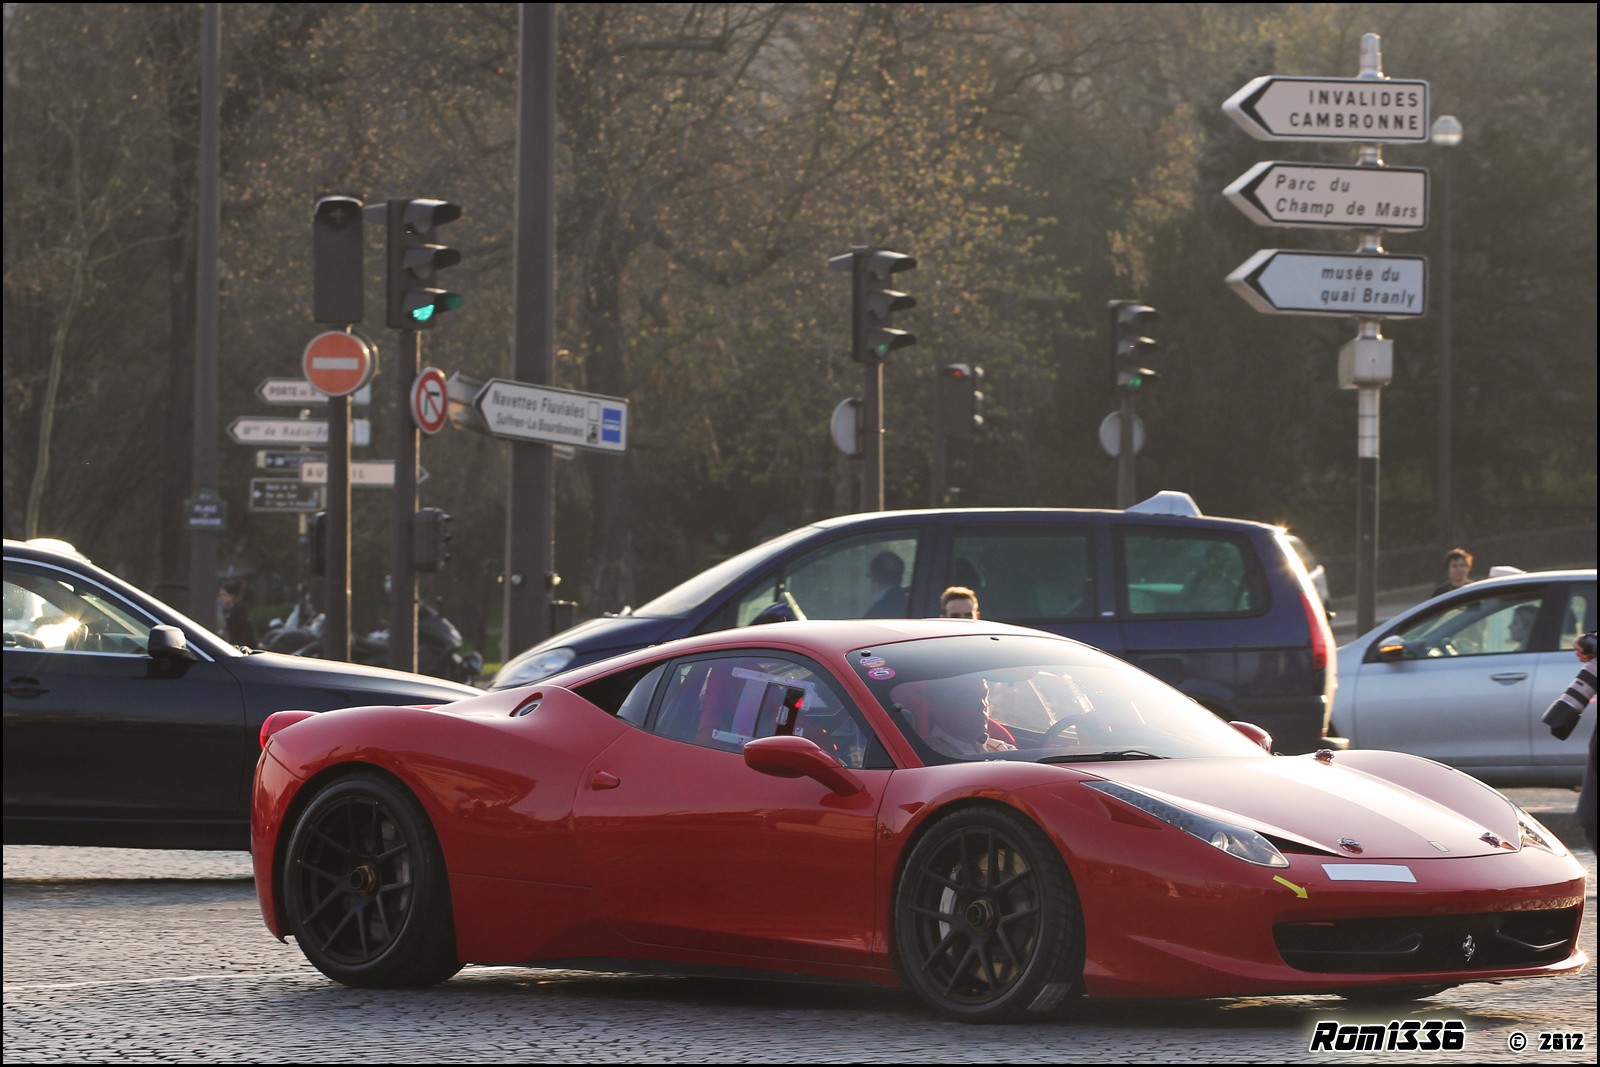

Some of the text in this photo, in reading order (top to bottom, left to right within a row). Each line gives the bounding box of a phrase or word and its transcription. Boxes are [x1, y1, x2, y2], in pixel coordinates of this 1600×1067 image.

[1309, 90, 1419, 108] INVALIDES
[1289, 112, 1419, 131] CAMBRONNE
[1275, 174, 1351, 193] Parc du
[1275, 198, 1418, 219] Champ de Mars
[1321, 265, 1400, 283] musée du
[1320, 288, 1416, 308] quai Branly
[269, 386, 298, 396] PORTE
[492, 390, 585, 419] Navettes Fluviales
